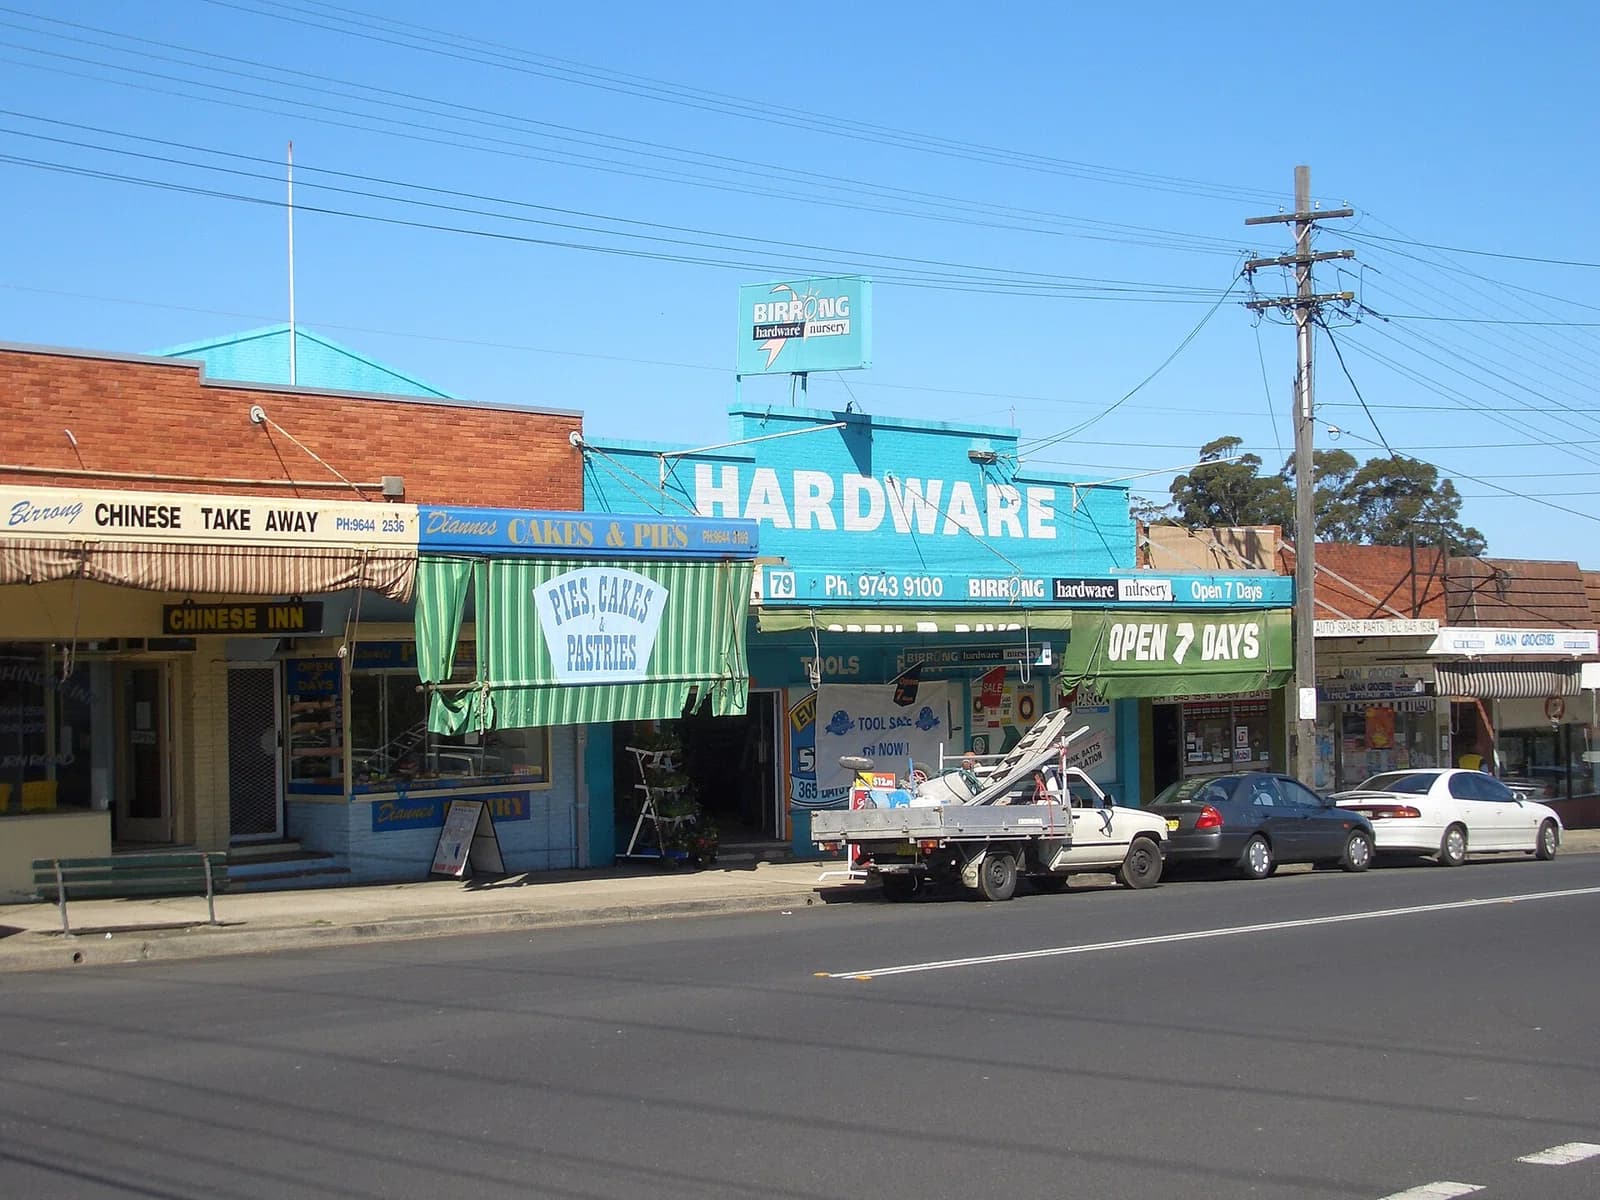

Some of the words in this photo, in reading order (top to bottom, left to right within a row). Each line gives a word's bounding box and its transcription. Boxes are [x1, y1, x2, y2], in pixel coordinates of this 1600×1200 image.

[753, 296, 849, 322] BIRRONG
[756, 326, 800, 338] hardware
[809, 321, 846, 334] nursery
[695, 463, 1057, 539] HARDWARE
[8, 501, 82, 526] Birrong
[95, 503, 181, 529] CHINESE
[201, 507, 251, 531] TAKE
[265, 509, 318, 533] AWAY
[336, 518, 375, 532] PH:9644
[382, 519, 405, 532] 2536
[426, 512, 498, 536] Diannes
[507, 517, 594, 548] CAKES
[606, 522, 626, 548] &
[633, 523, 689, 549] PIES
[772, 574, 793, 594] 79
[825, 575, 852, 596] Ph.
[858, 575, 899, 597] 9743
[903, 576, 943, 597] 9100
[968, 577, 1044, 598] BIRRONG
[1056, 581, 1115, 598] hardware
[1125, 580, 1168, 600] nursery
[1191, 581, 1222, 600] Open
[1225, 582, 1232, 598] 7
[1236, 581, 1263, 600] Days
[549, 578, 598, 625] PIES,
[599, 575, 652, 625] CAKES
[169, 607, 256, 630] CHINESE
[268, 607, 304, 629] INN
[598, 616, 606, 632] &
[1315, 621, 1335, 634] AUTO
[1337, 621, 1361, 633] SPARE
[1363, 621, 1385, 633] PARTS
[1108, 623, 1168, 661] OPEN
[1172, 622, 1194, 664] 7
[1201, 622, 1260, 661] DAYS
[1495, 633, 1517, 646] ASIAN
[1521, 633, 1555, 647] GROCERIES
[567, 634, 637, 672] PASTRIES
[907, 651, 959, 663] BIRRONG
[963, 650, 1000, 660] hardware
[801, 655, 859, 674] TOOLS
[297, 680, 335, 691] DAYS
[983, 682, 1003, 693] SALE
[858, 717, 886, 731] TOOL
[1081, 742, 1101, 758] BATTS
[799, 781, 817, 799] 365
